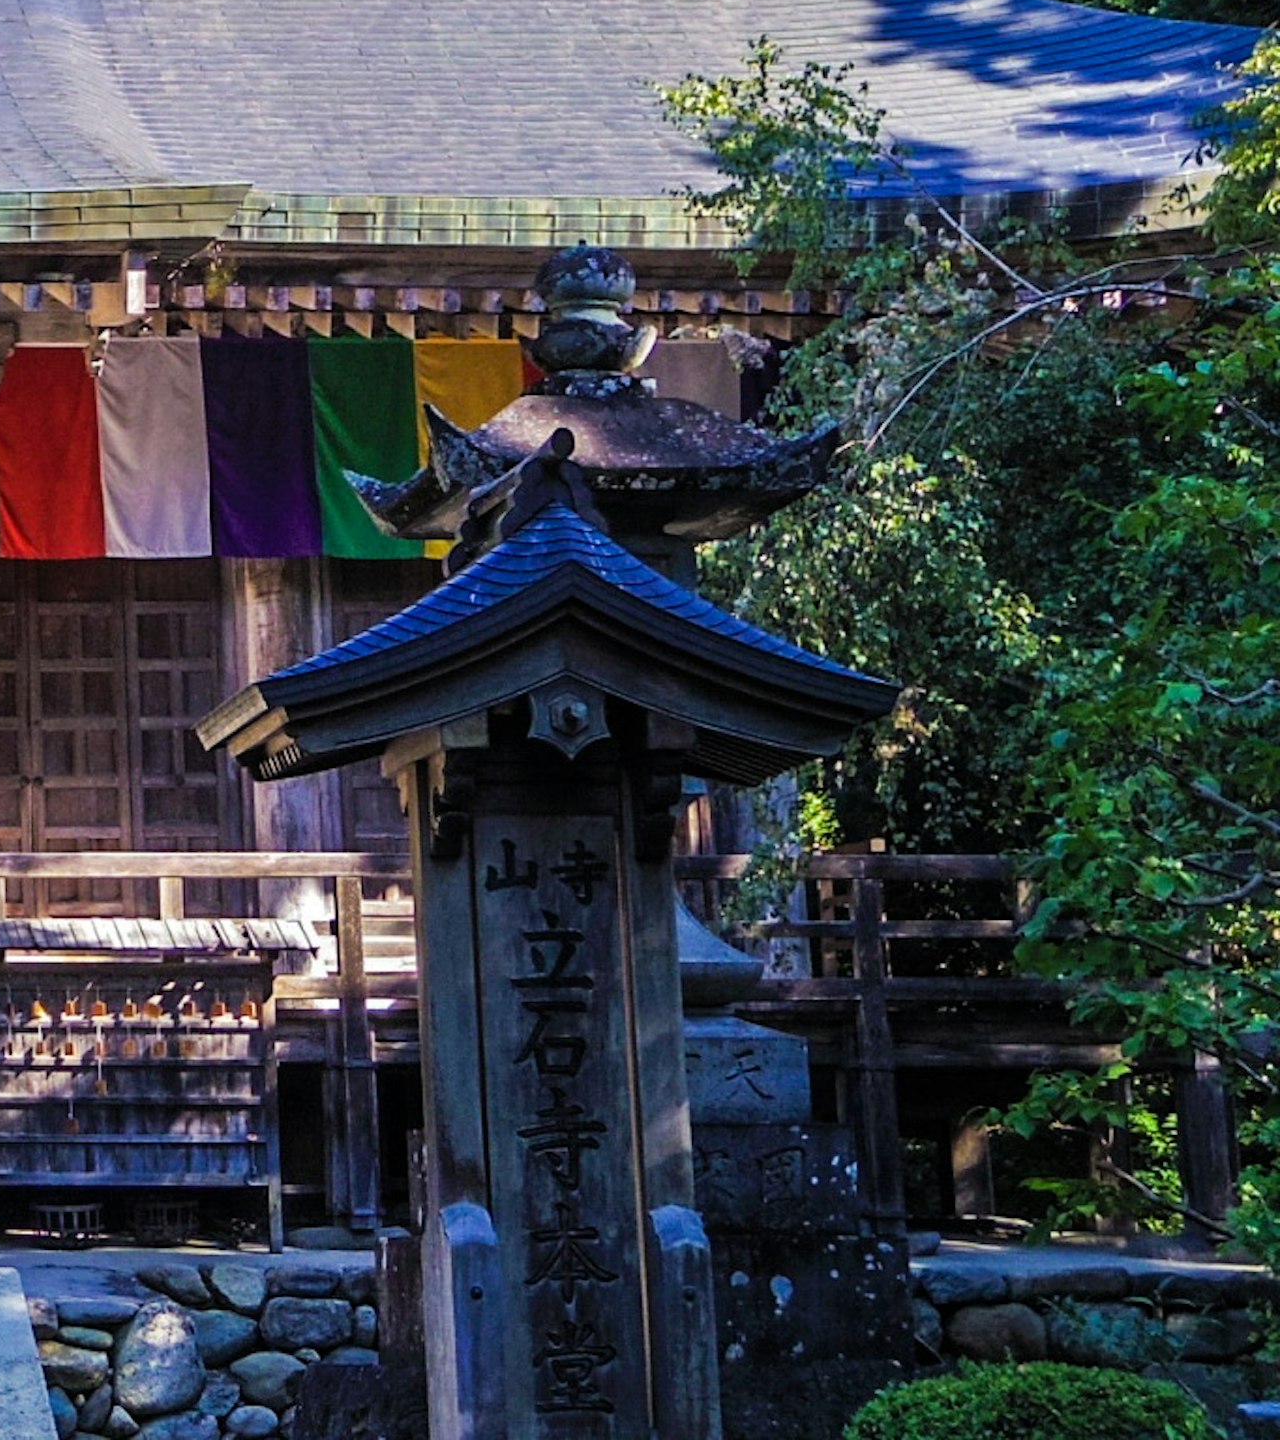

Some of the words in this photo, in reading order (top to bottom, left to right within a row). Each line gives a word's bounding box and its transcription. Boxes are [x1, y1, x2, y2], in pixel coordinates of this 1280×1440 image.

[485, 838, 609, 906] 山寺
[509, 909, 618, 1414] 立石寺本堂
